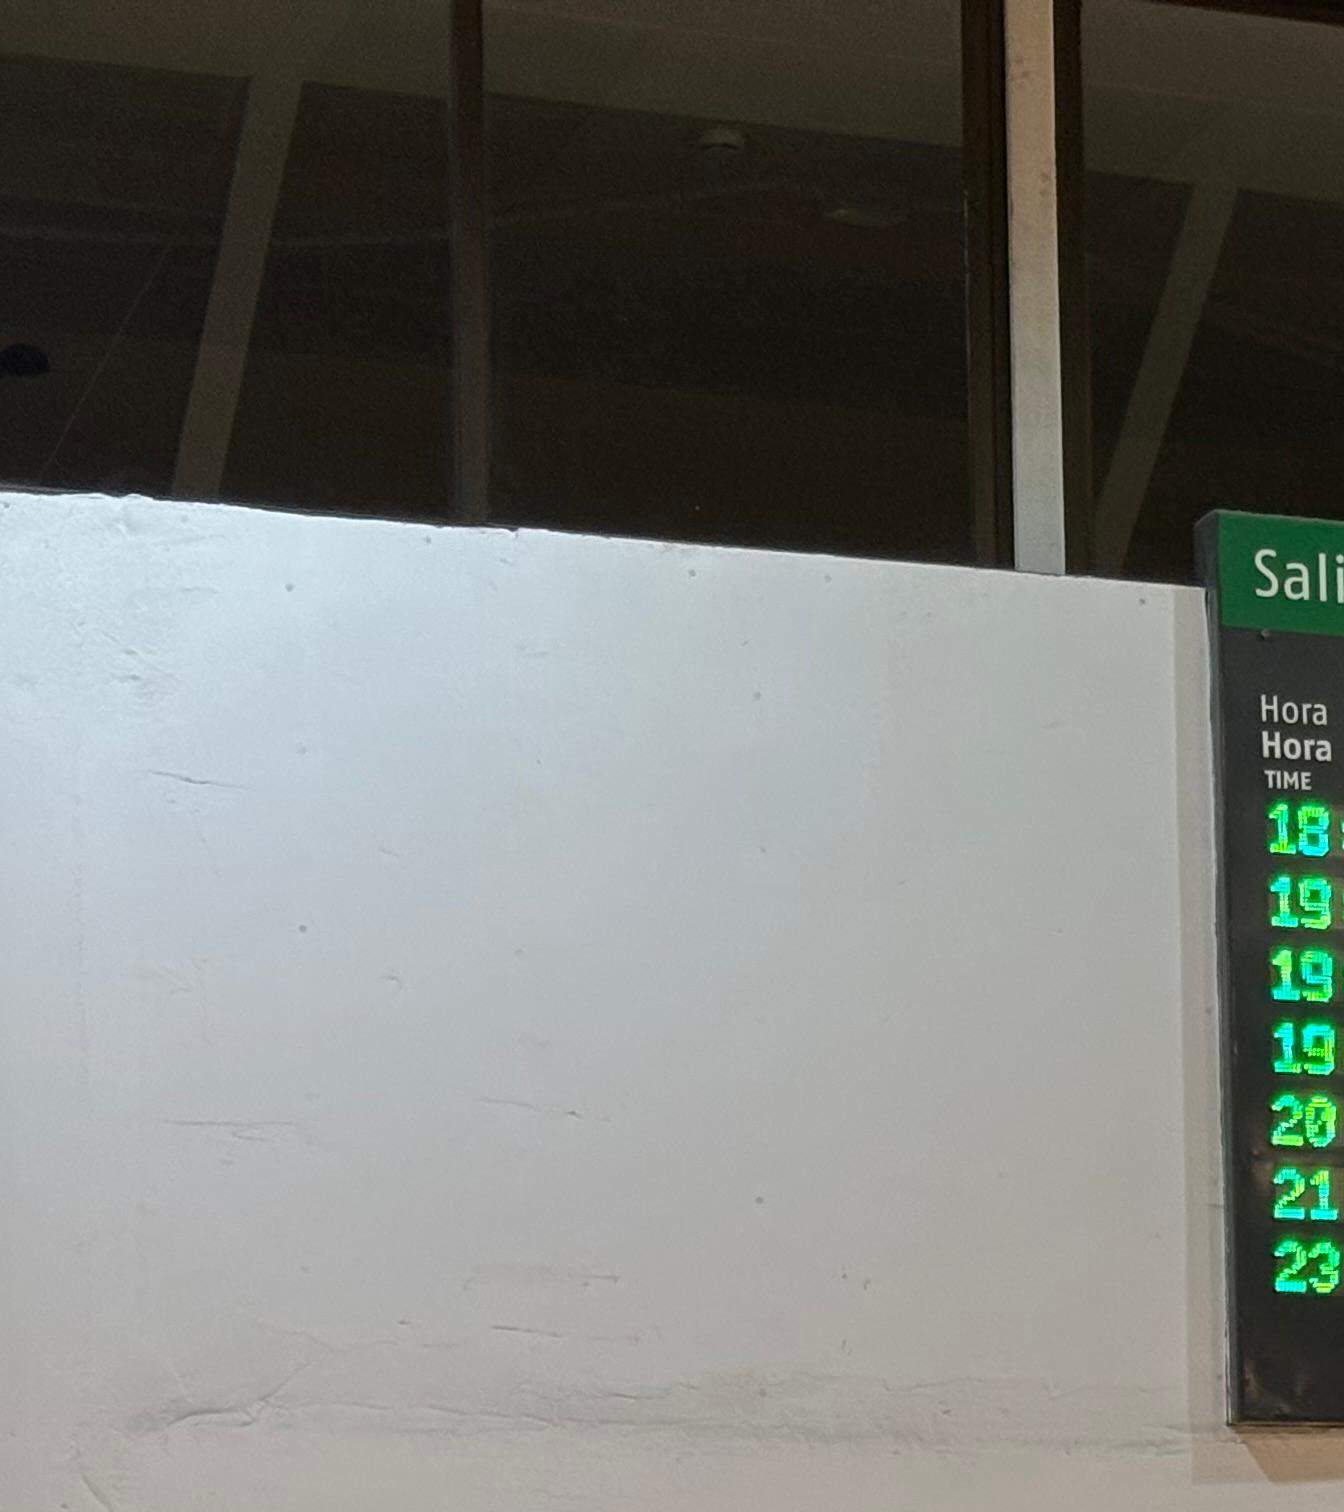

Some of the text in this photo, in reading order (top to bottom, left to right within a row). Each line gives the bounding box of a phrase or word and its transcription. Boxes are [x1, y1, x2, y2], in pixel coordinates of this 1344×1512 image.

[1261, 695, 1327, 725] Hora
[1262, 731, 1331, 761] Hora
[1265, 770, 1311, 790] TIME
